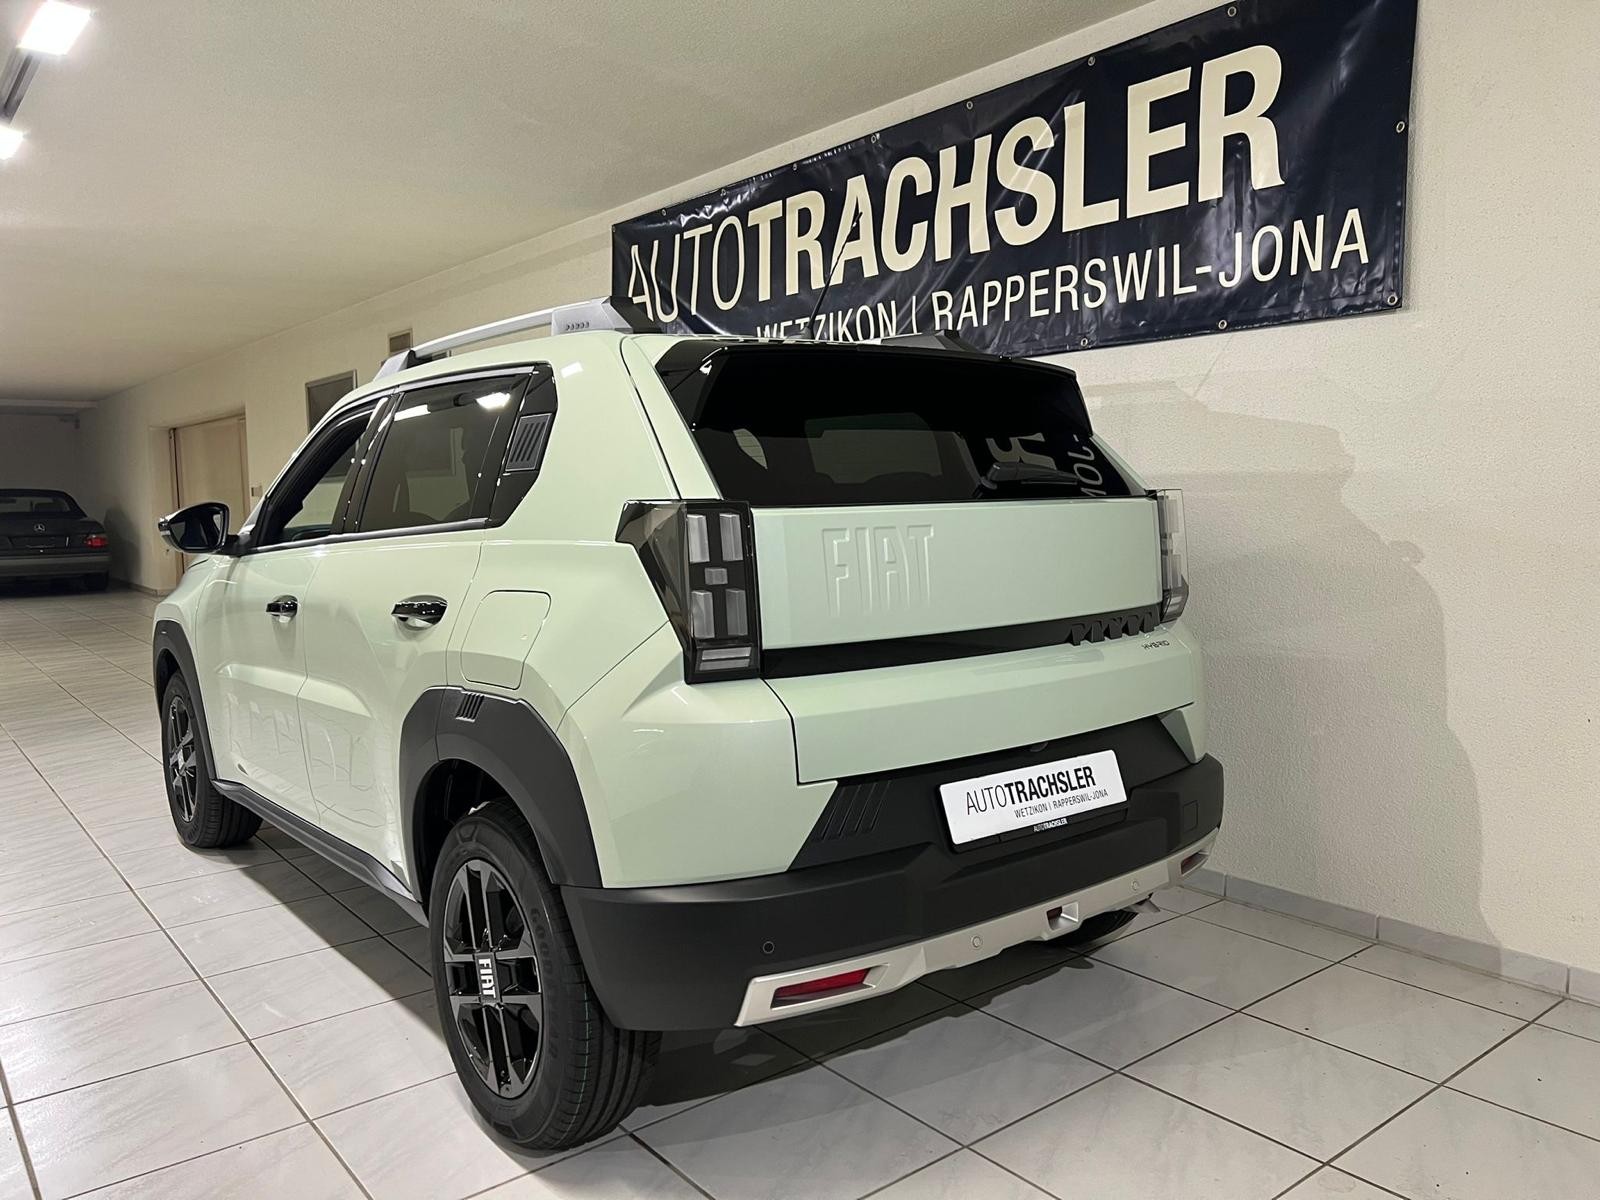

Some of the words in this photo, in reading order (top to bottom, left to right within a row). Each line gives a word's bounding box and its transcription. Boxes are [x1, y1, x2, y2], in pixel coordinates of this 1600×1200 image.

[628, 44, 1285, 323] AUTOTRACHSLER
[931, 208, 1369, 331] RAPPERSWIL-JONA
[822, 524, 934, 616] FIAT
[966, 765, 1096, 815] AUTOTRACHSLER
[1014, 802, 1048, 818] WETZIKON
[1053, 788, 1109, 809] RAPPERSWIL-JONA
[478, 958, 497, 999] FIAT
